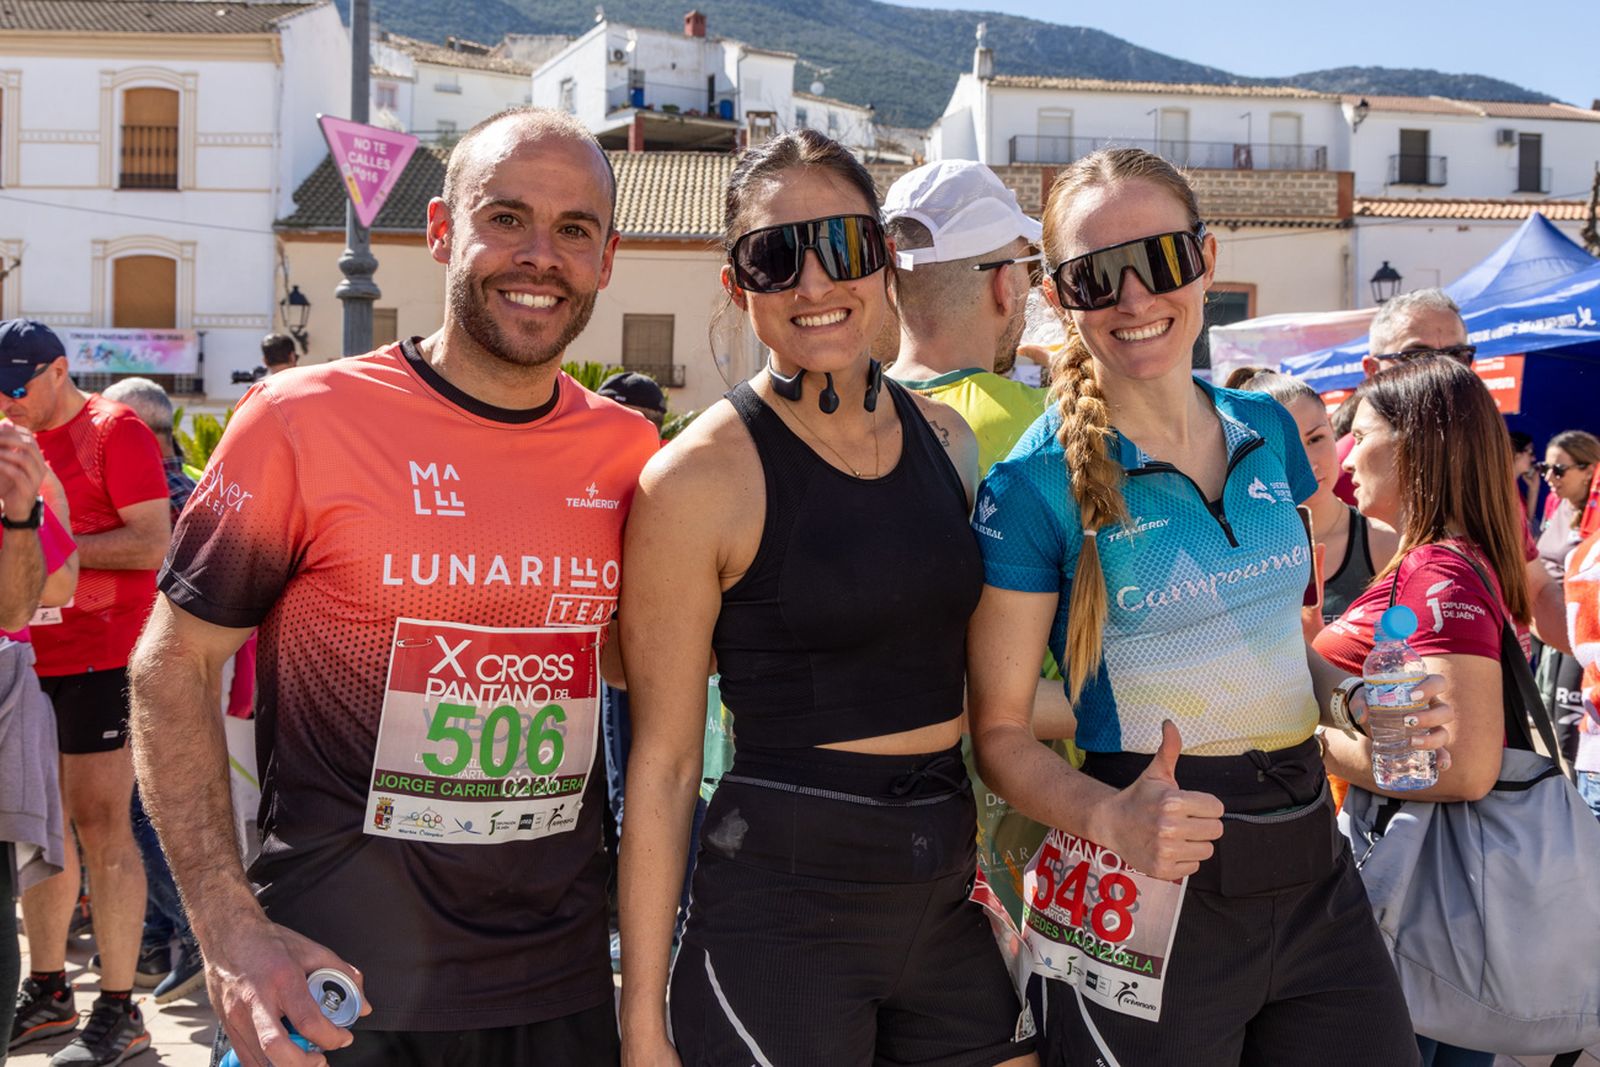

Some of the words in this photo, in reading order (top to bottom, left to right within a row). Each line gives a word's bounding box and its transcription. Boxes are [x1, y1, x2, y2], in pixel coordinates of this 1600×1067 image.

[353, 137, 371, 151] NO
[373, 141, 388, 155] TE
[348, 151, 391, 171] CALLES
[565, 497, 620, 509] TEAMERGY
[382, 554, 620, 589] LUNARILLO
[1441, 601, 1486, 617] DIPUTACIÓN
[1443, 610, 1455, 618] DE
[1455, 611, 1475, 620] JAÉN
[428, 634, 473, 679] X
[475, 653, 575, 682] CROSS
[424, 677, 552, 709] PANTANO
[422, 702, 567, 778] 506
[374, 773, 436, 795] JORGE
[1032, 842, 1138, 942] 548
